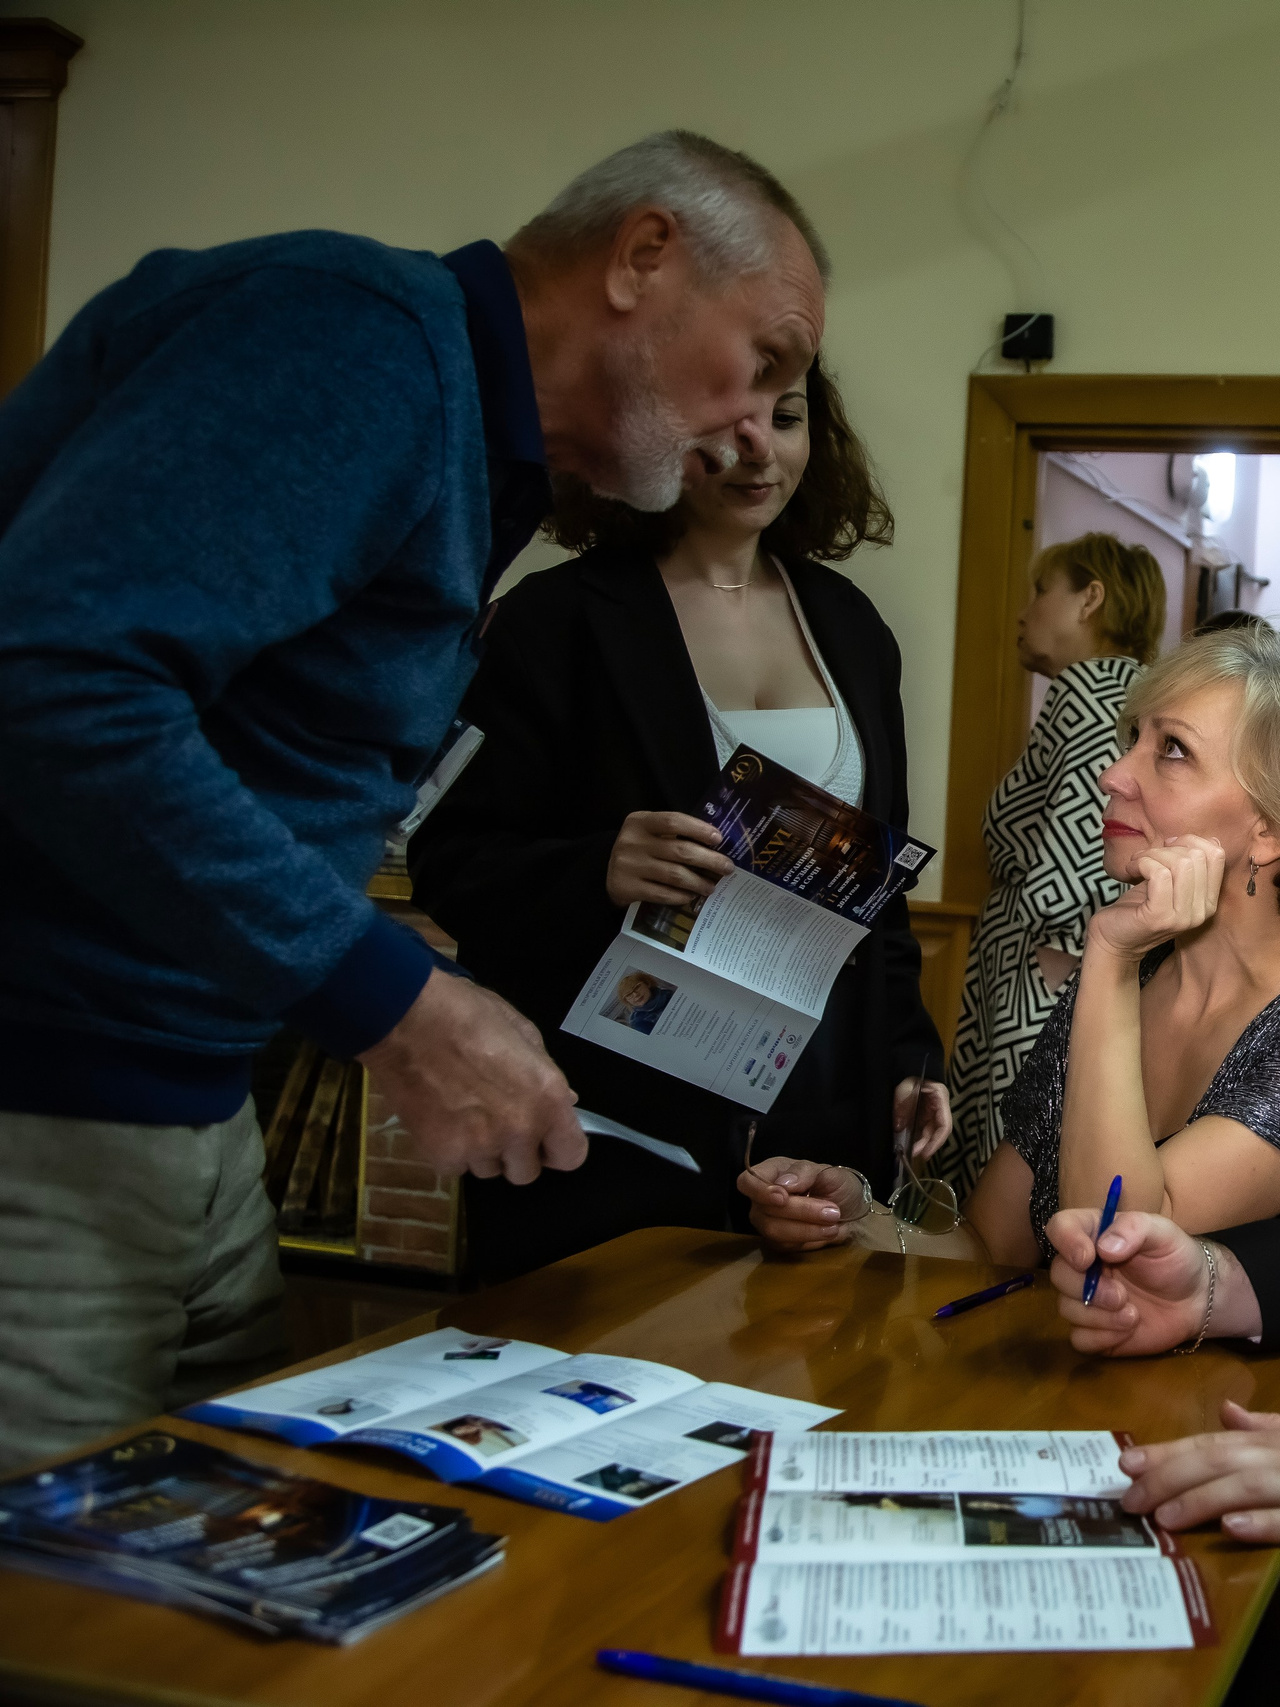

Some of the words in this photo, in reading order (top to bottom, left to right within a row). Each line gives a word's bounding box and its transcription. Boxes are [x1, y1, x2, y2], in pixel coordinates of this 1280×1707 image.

[730, 762, 750, 783] 40
[749, 827, 793, 870] XXVI
[781, 844, 815, 883] ОРГАННОЙ
[789, 856, 817, 886] МУЗЫКИ
[802, 865, 822, 885] СОЧИ
[836, 870, 858, 893] октября
[847, 882, 861, 895] года
